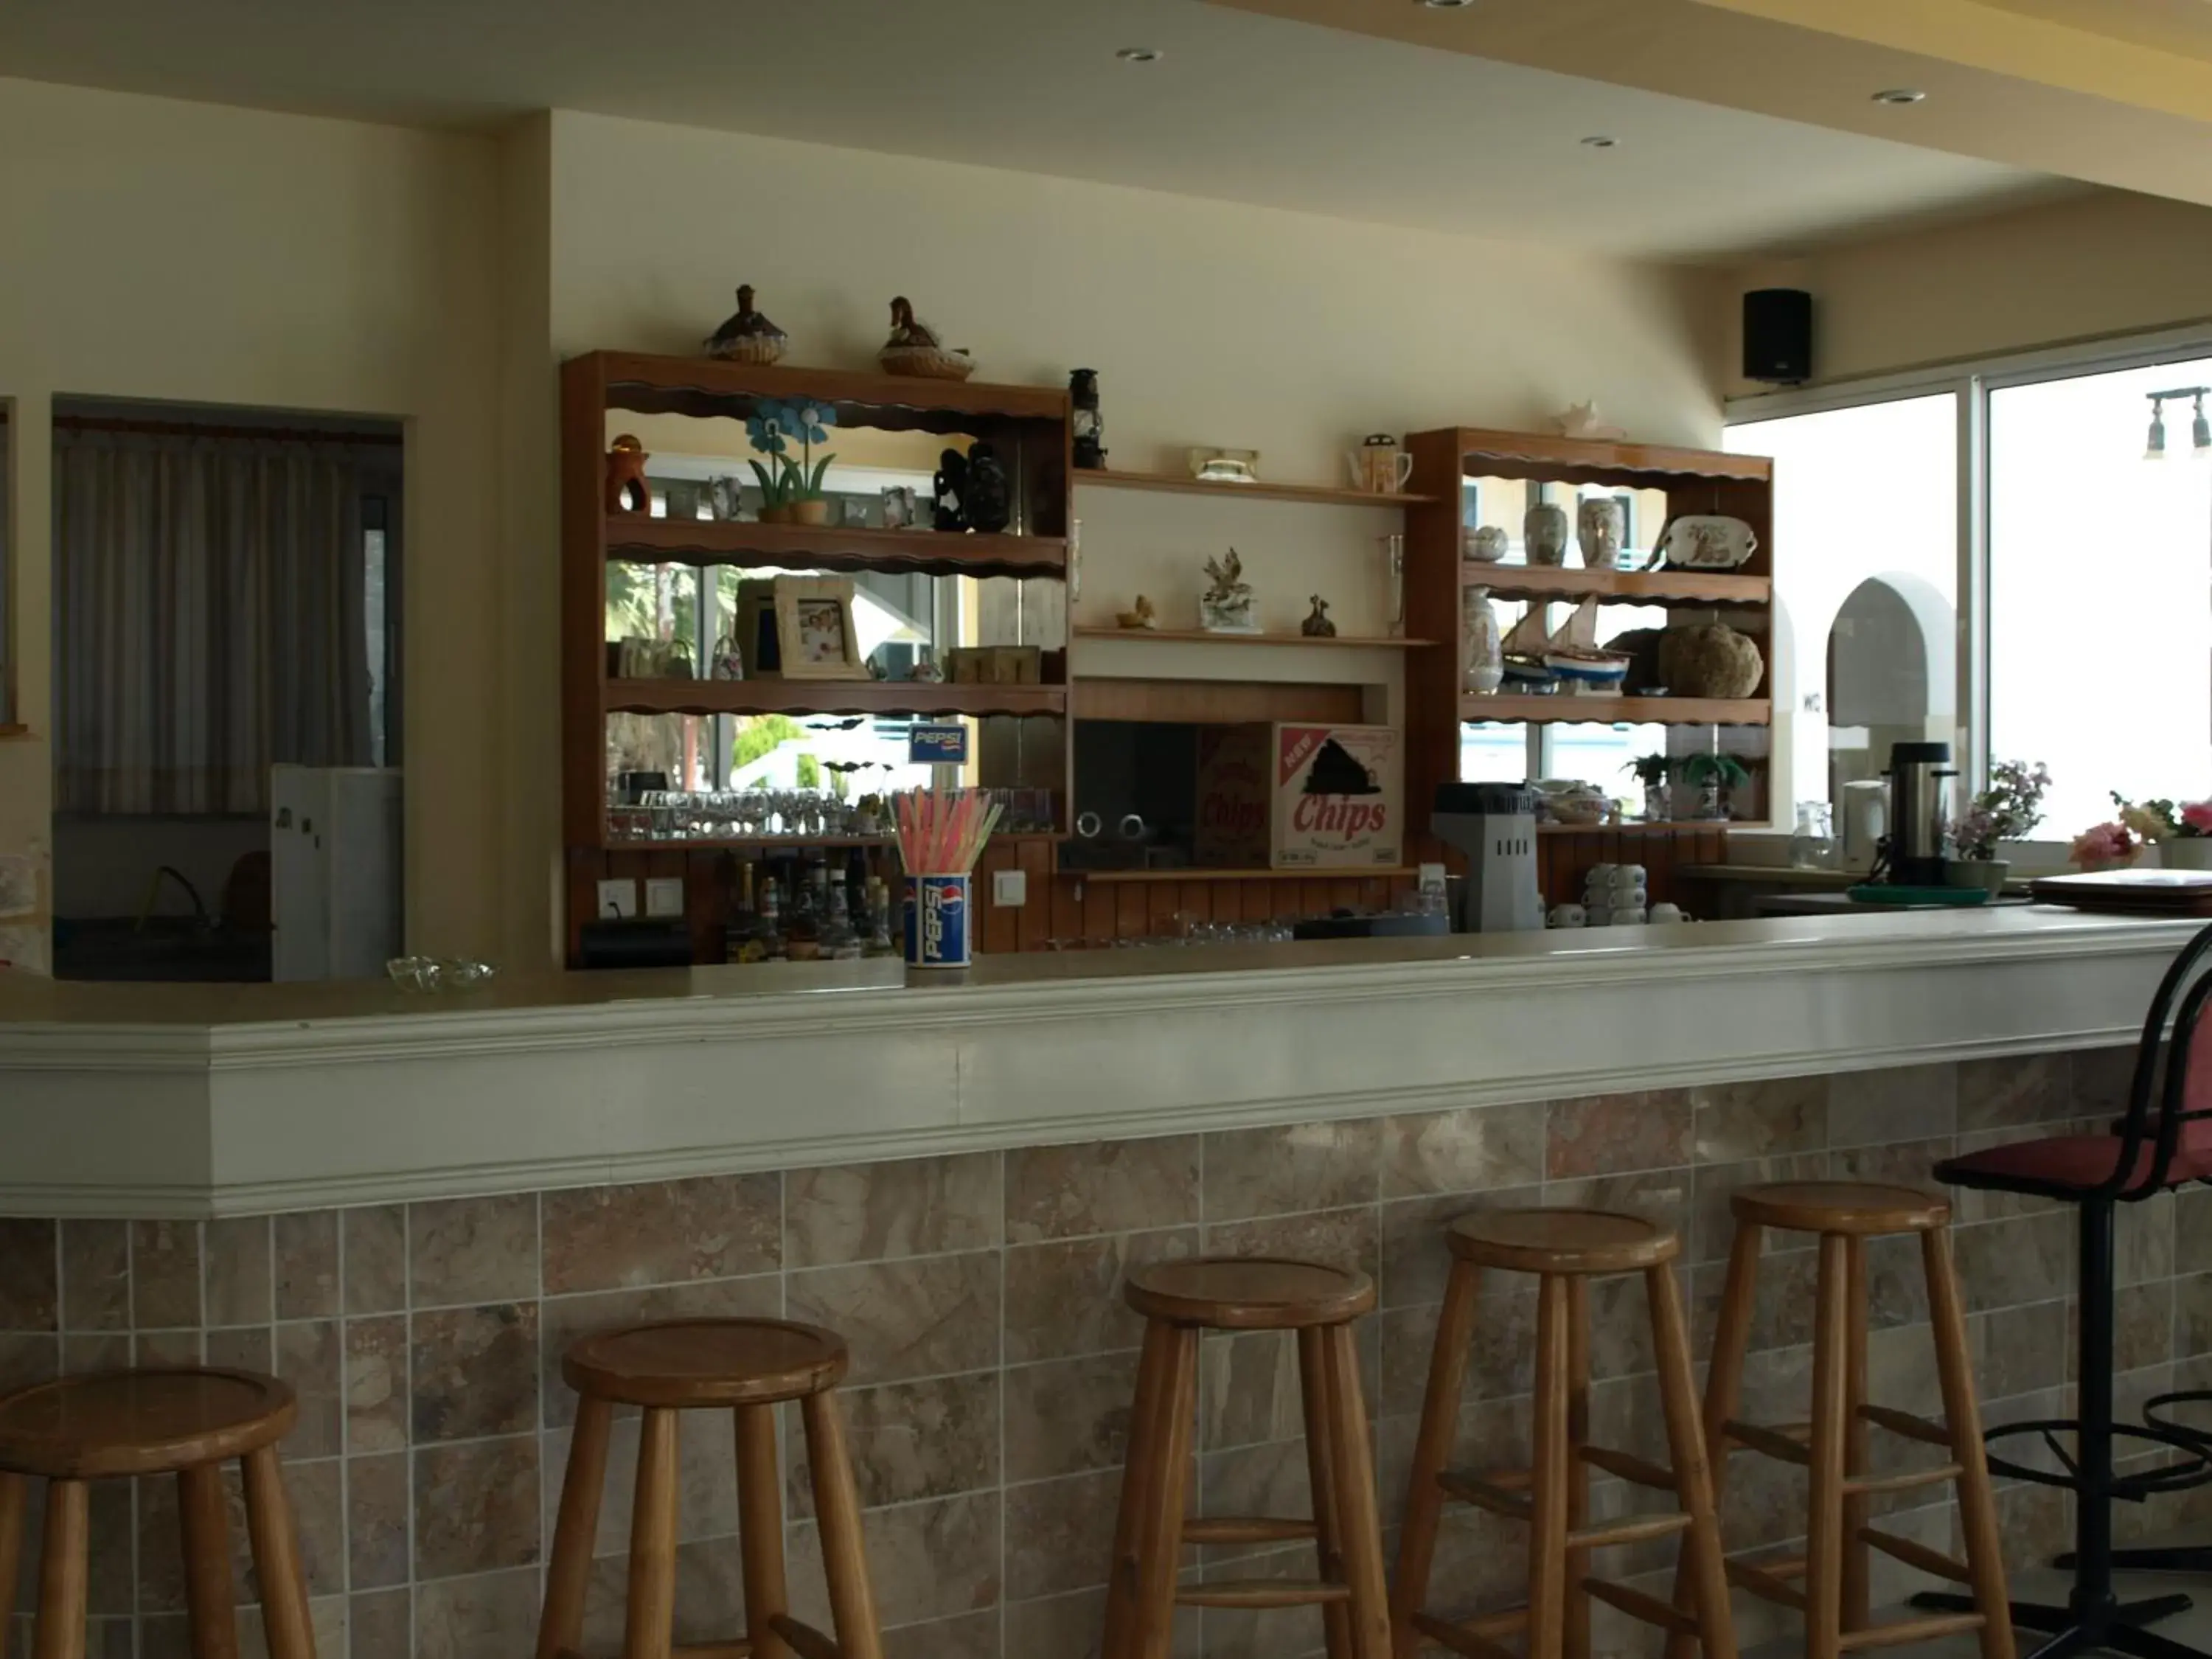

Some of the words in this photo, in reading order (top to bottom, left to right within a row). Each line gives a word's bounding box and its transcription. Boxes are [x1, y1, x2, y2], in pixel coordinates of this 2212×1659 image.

[914, 731, 961, 744] PEPSI
[1284, 732, 1311, 768] NEW
[1293, 793, 1386, 841] Chips
[925, 884, 943, 959] PEPSI
